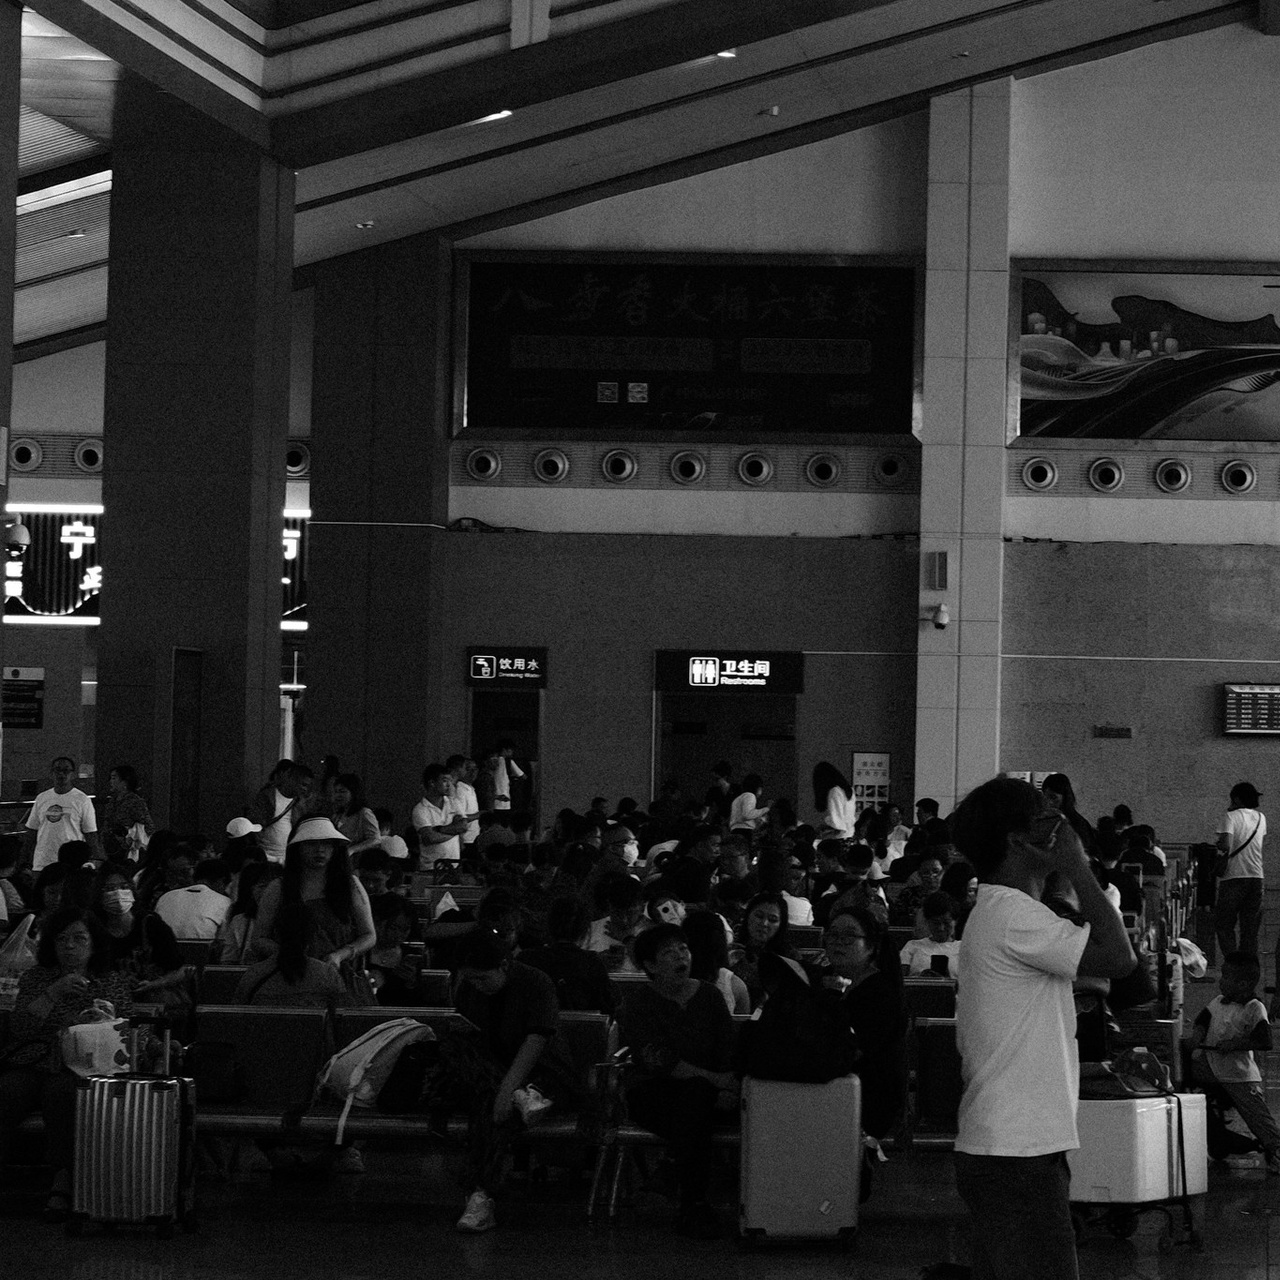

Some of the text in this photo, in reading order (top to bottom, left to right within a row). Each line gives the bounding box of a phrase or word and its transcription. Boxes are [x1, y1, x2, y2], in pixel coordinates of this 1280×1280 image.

[498, 658, 540, 671] 饮用水
[720, 659, 770, 677] 卫生间
